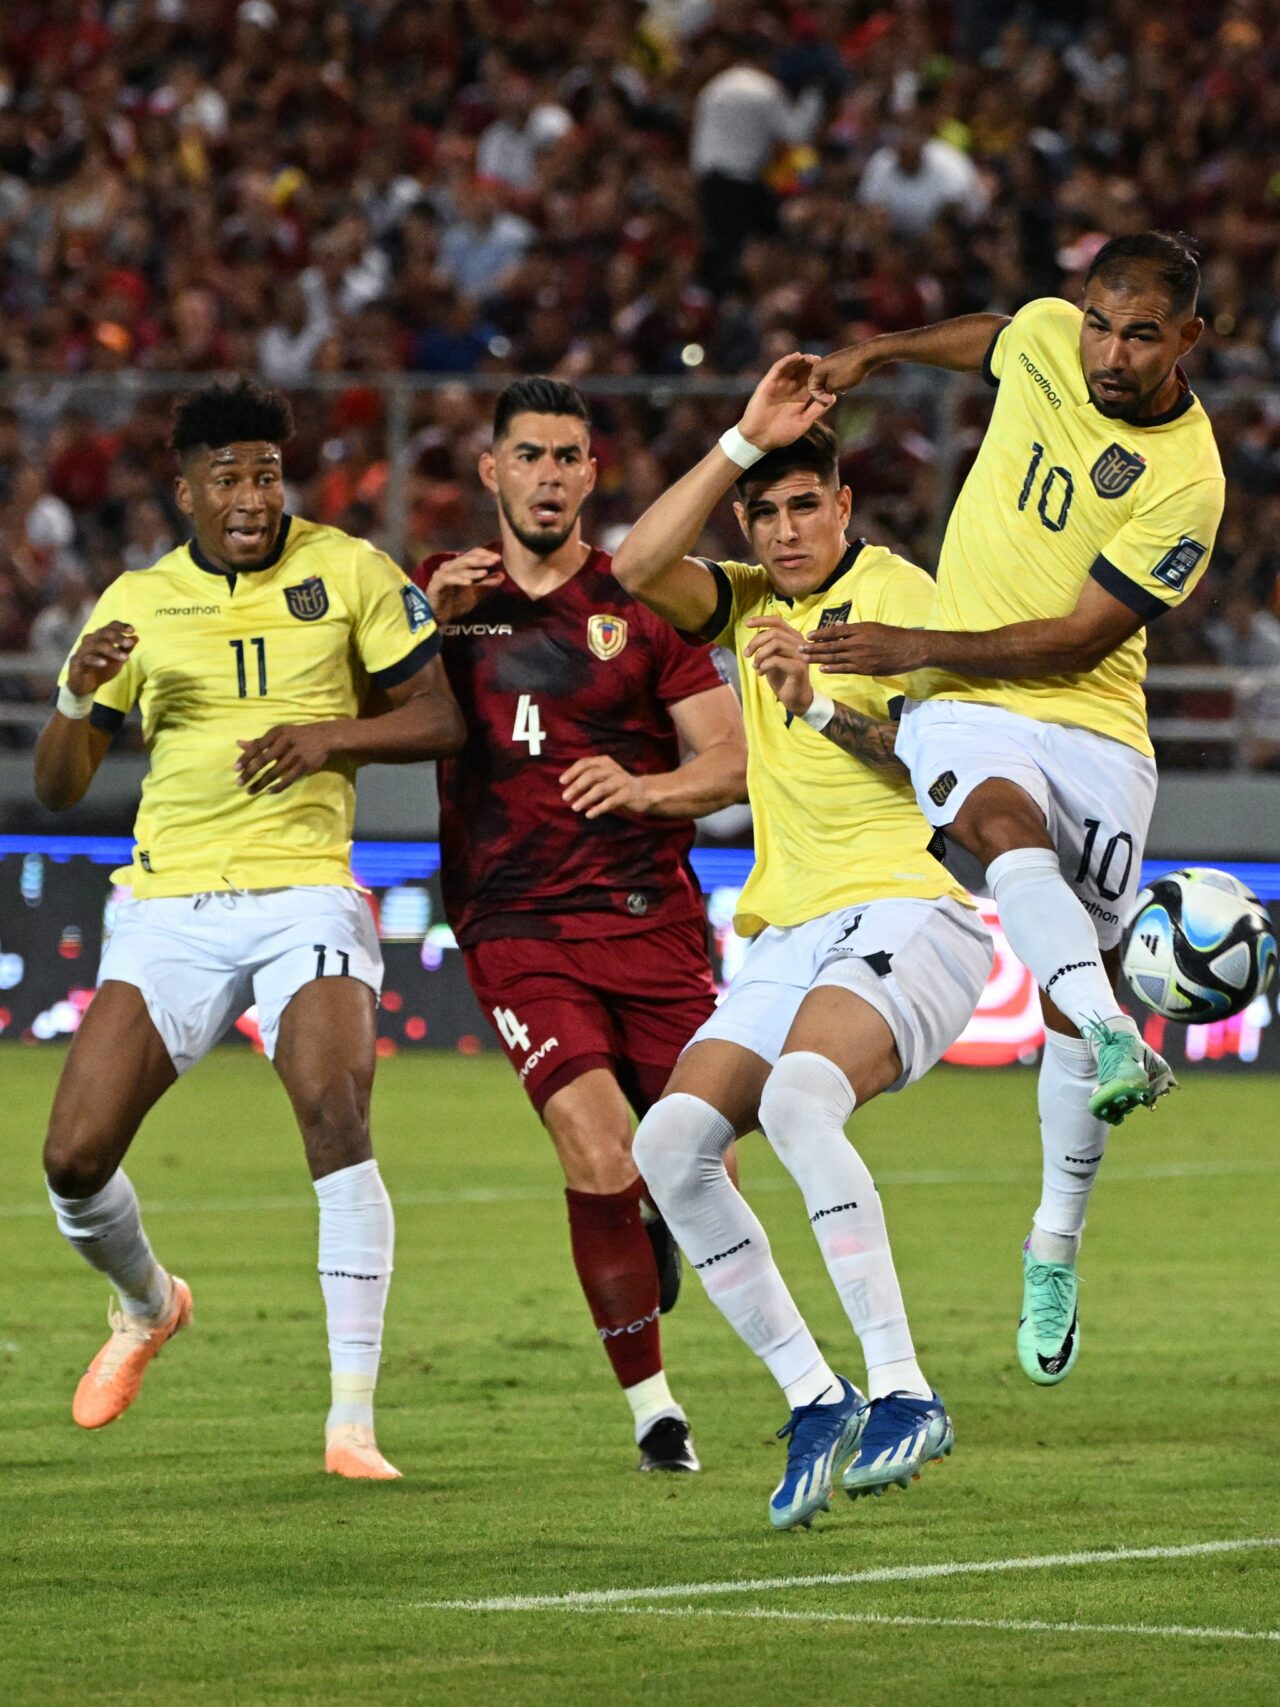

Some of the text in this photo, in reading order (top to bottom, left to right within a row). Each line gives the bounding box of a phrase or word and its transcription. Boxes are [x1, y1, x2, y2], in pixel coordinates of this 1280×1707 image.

[1018, 352, 1062, 410] marathon
[1018, 442, 1074, 532] 10
[155, 605, 221, 617] marathon
[444, 624, 513, 636] GIVOVA
[229, 637, 268, 698] 11
[511, 694, 547, 756] 4
[1074, 817, 1133, 902] 10
[1079, 898, 1119, 925] athon
[1045, 961, 1097, 995] rathon
[492, 1006, 531, 1052] 4
[519, 1036, 559, 1081] IVOVA
[809, 1201, 858, 1225] rathon
